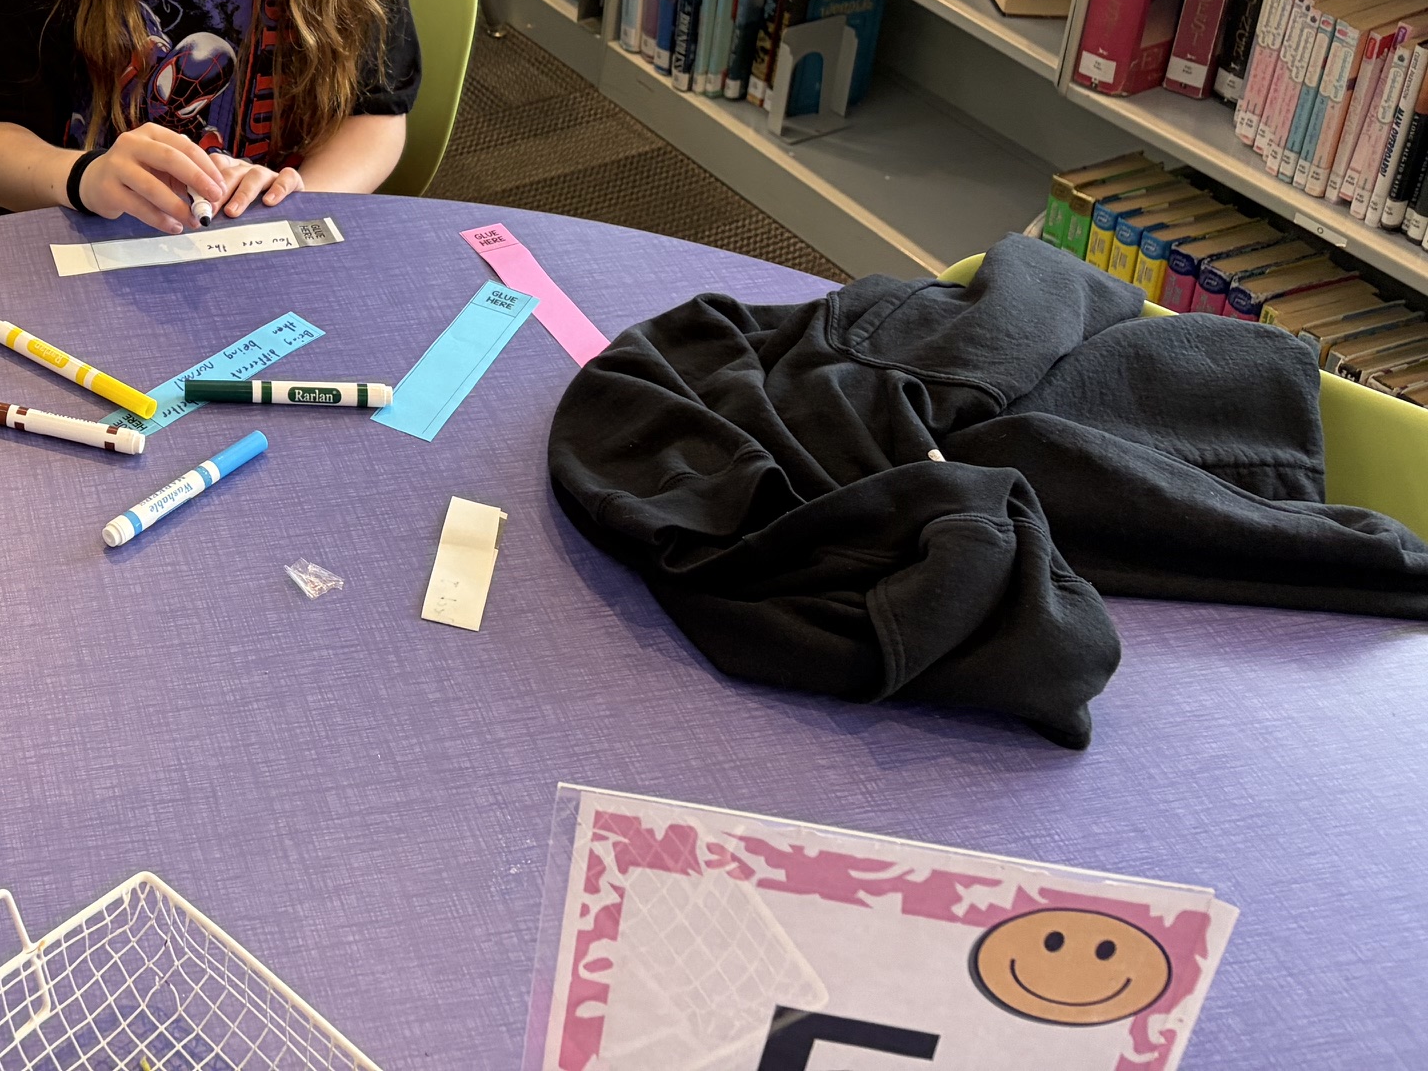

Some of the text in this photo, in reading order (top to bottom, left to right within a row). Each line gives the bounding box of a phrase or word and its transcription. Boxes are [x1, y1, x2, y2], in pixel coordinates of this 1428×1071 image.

[1392, 105, 1406, 128] MAN
[298, 225, 314, 240] HERE
[310, 224, 326, 239] GLUE
[474, 229, 500, 240] GLUE
[478, 235, 506, 247] HERE
[485, 296, 515, 310] HERE
[491, 290, 519, 303] GLUE
[222, 339, 262, 360] being
[230, 348, 280, 380] different
[173, 361, 215, 392] normal
[122, 413, 148, 432] HERE
[149, 481, 194, 514] Washable
